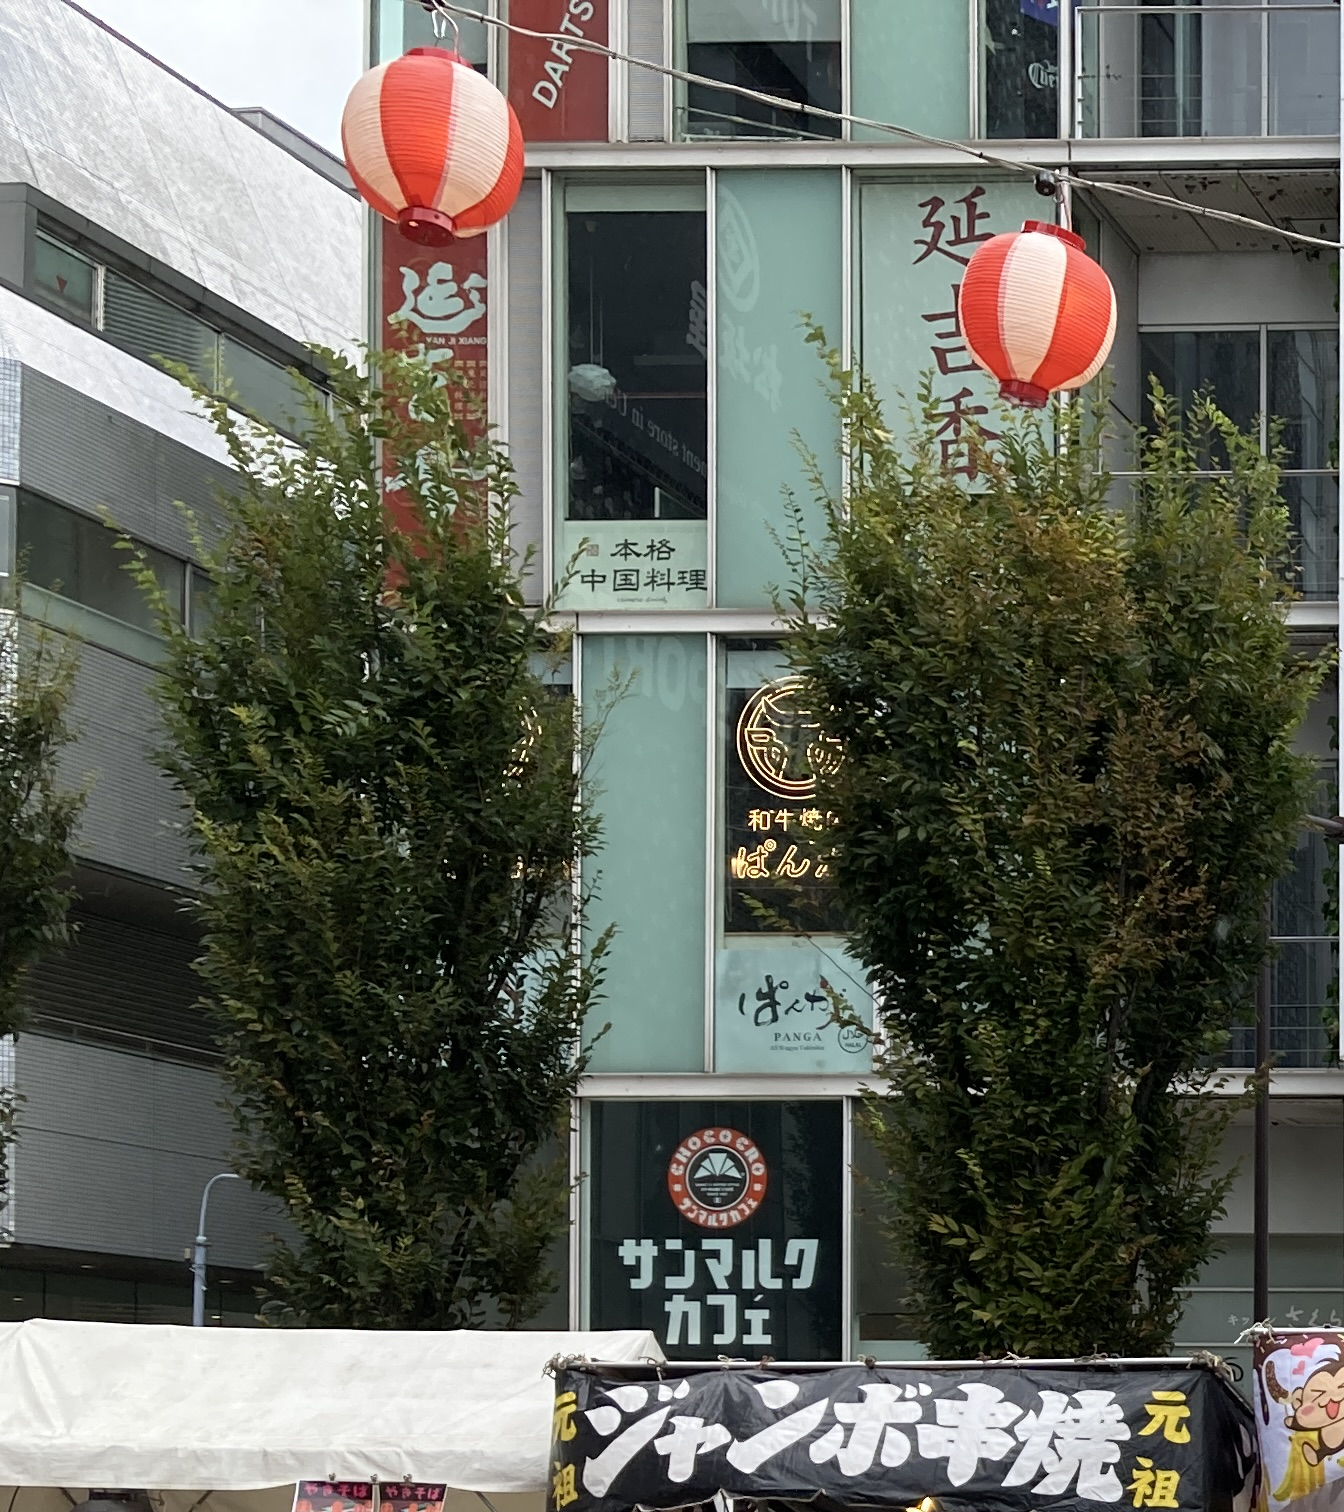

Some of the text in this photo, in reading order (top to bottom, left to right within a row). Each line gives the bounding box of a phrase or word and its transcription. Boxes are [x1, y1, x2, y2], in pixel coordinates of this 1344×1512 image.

[532, 0, 594, 109] DARTS
[610, 538, 676, 562] 本格
[580, 568, 709, 593] 中国料理
[774, 1032, 823, 1043] PANGA
[618, 1238, 819, 1290] サンマルク
[665, 1293, 773, 1345] カフェ
[584, 1379, 1133, 1502] ジャンボ串焼
[1127, 1390, 1192, 1509] 元祖
[304, 1482, 368, 1498] やきそば
[385, 1485, 442, 1499] やきそば
